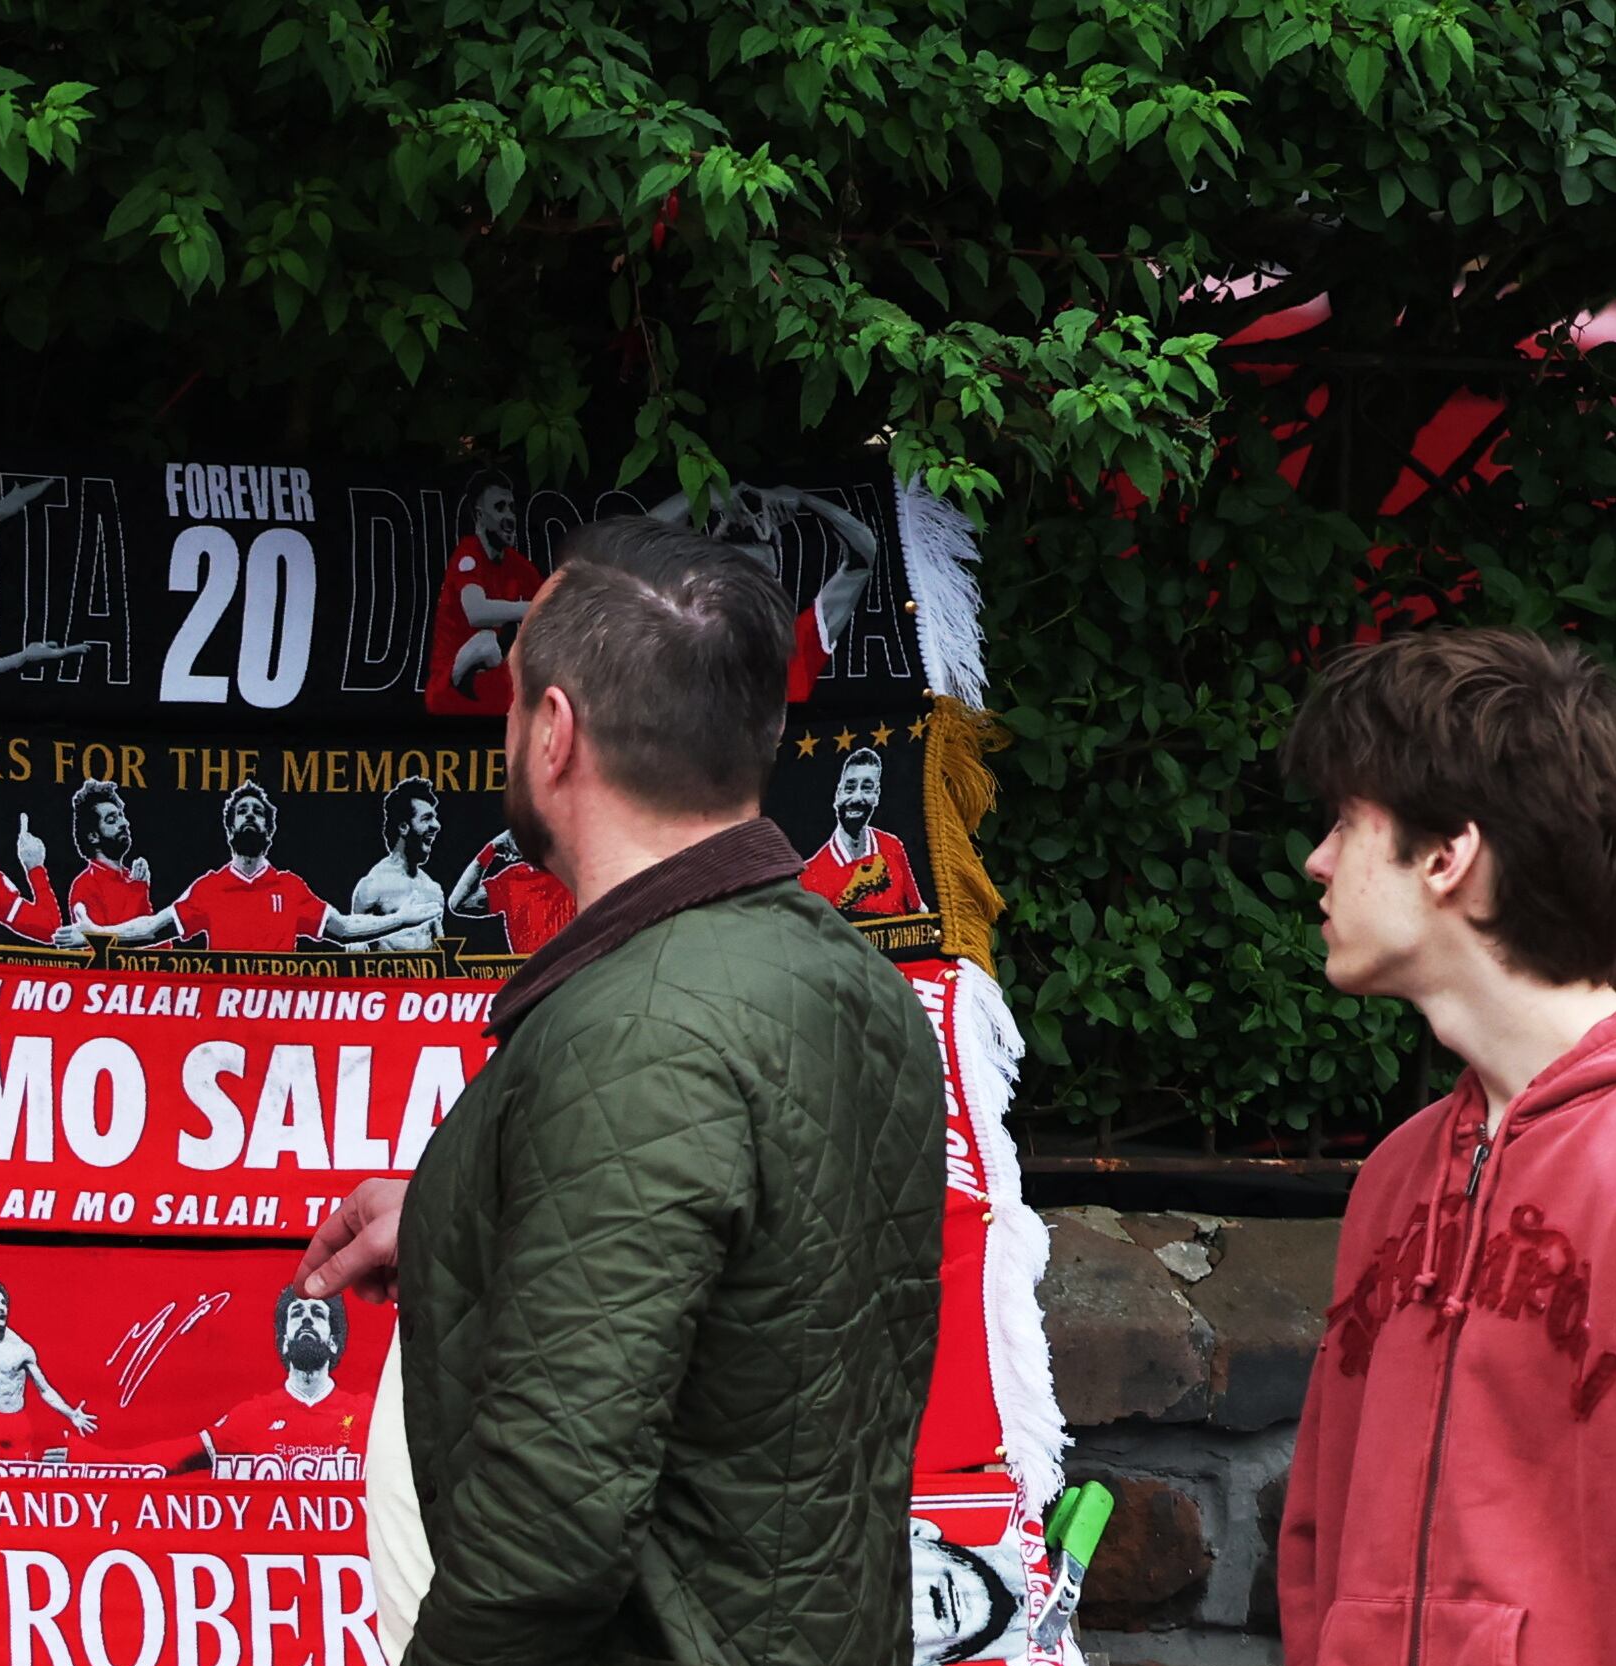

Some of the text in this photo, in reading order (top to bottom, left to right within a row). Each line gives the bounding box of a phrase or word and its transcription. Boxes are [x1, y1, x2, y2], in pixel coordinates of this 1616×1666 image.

[165, 462, 316, 522] FOREVER
[159, 525, 317, 709] 20
[52, 740, 148, 789] FOR
[169, 748, 260, 792] THE
[282, 749, 507, 793] MEMORIE
[271, 894, 283, 913] 11
[221, 958, 339, 977] LIVERPOOL
[350, 957, 437, 978] LEGEND
[11, 980, 72, 1012] MO
[83, 983, 202, 1020] SALAH,
[216, 988, 386, 1022] RUNNING
[178, 1040, 497, 1170] SALA
[72, 1190, 135, 1223] MO
[152, 1193, 288, 1229] SALAH,
[291, 1455, 360, 1480] SAL
[135, 1493, 251, 1530] ANDY
